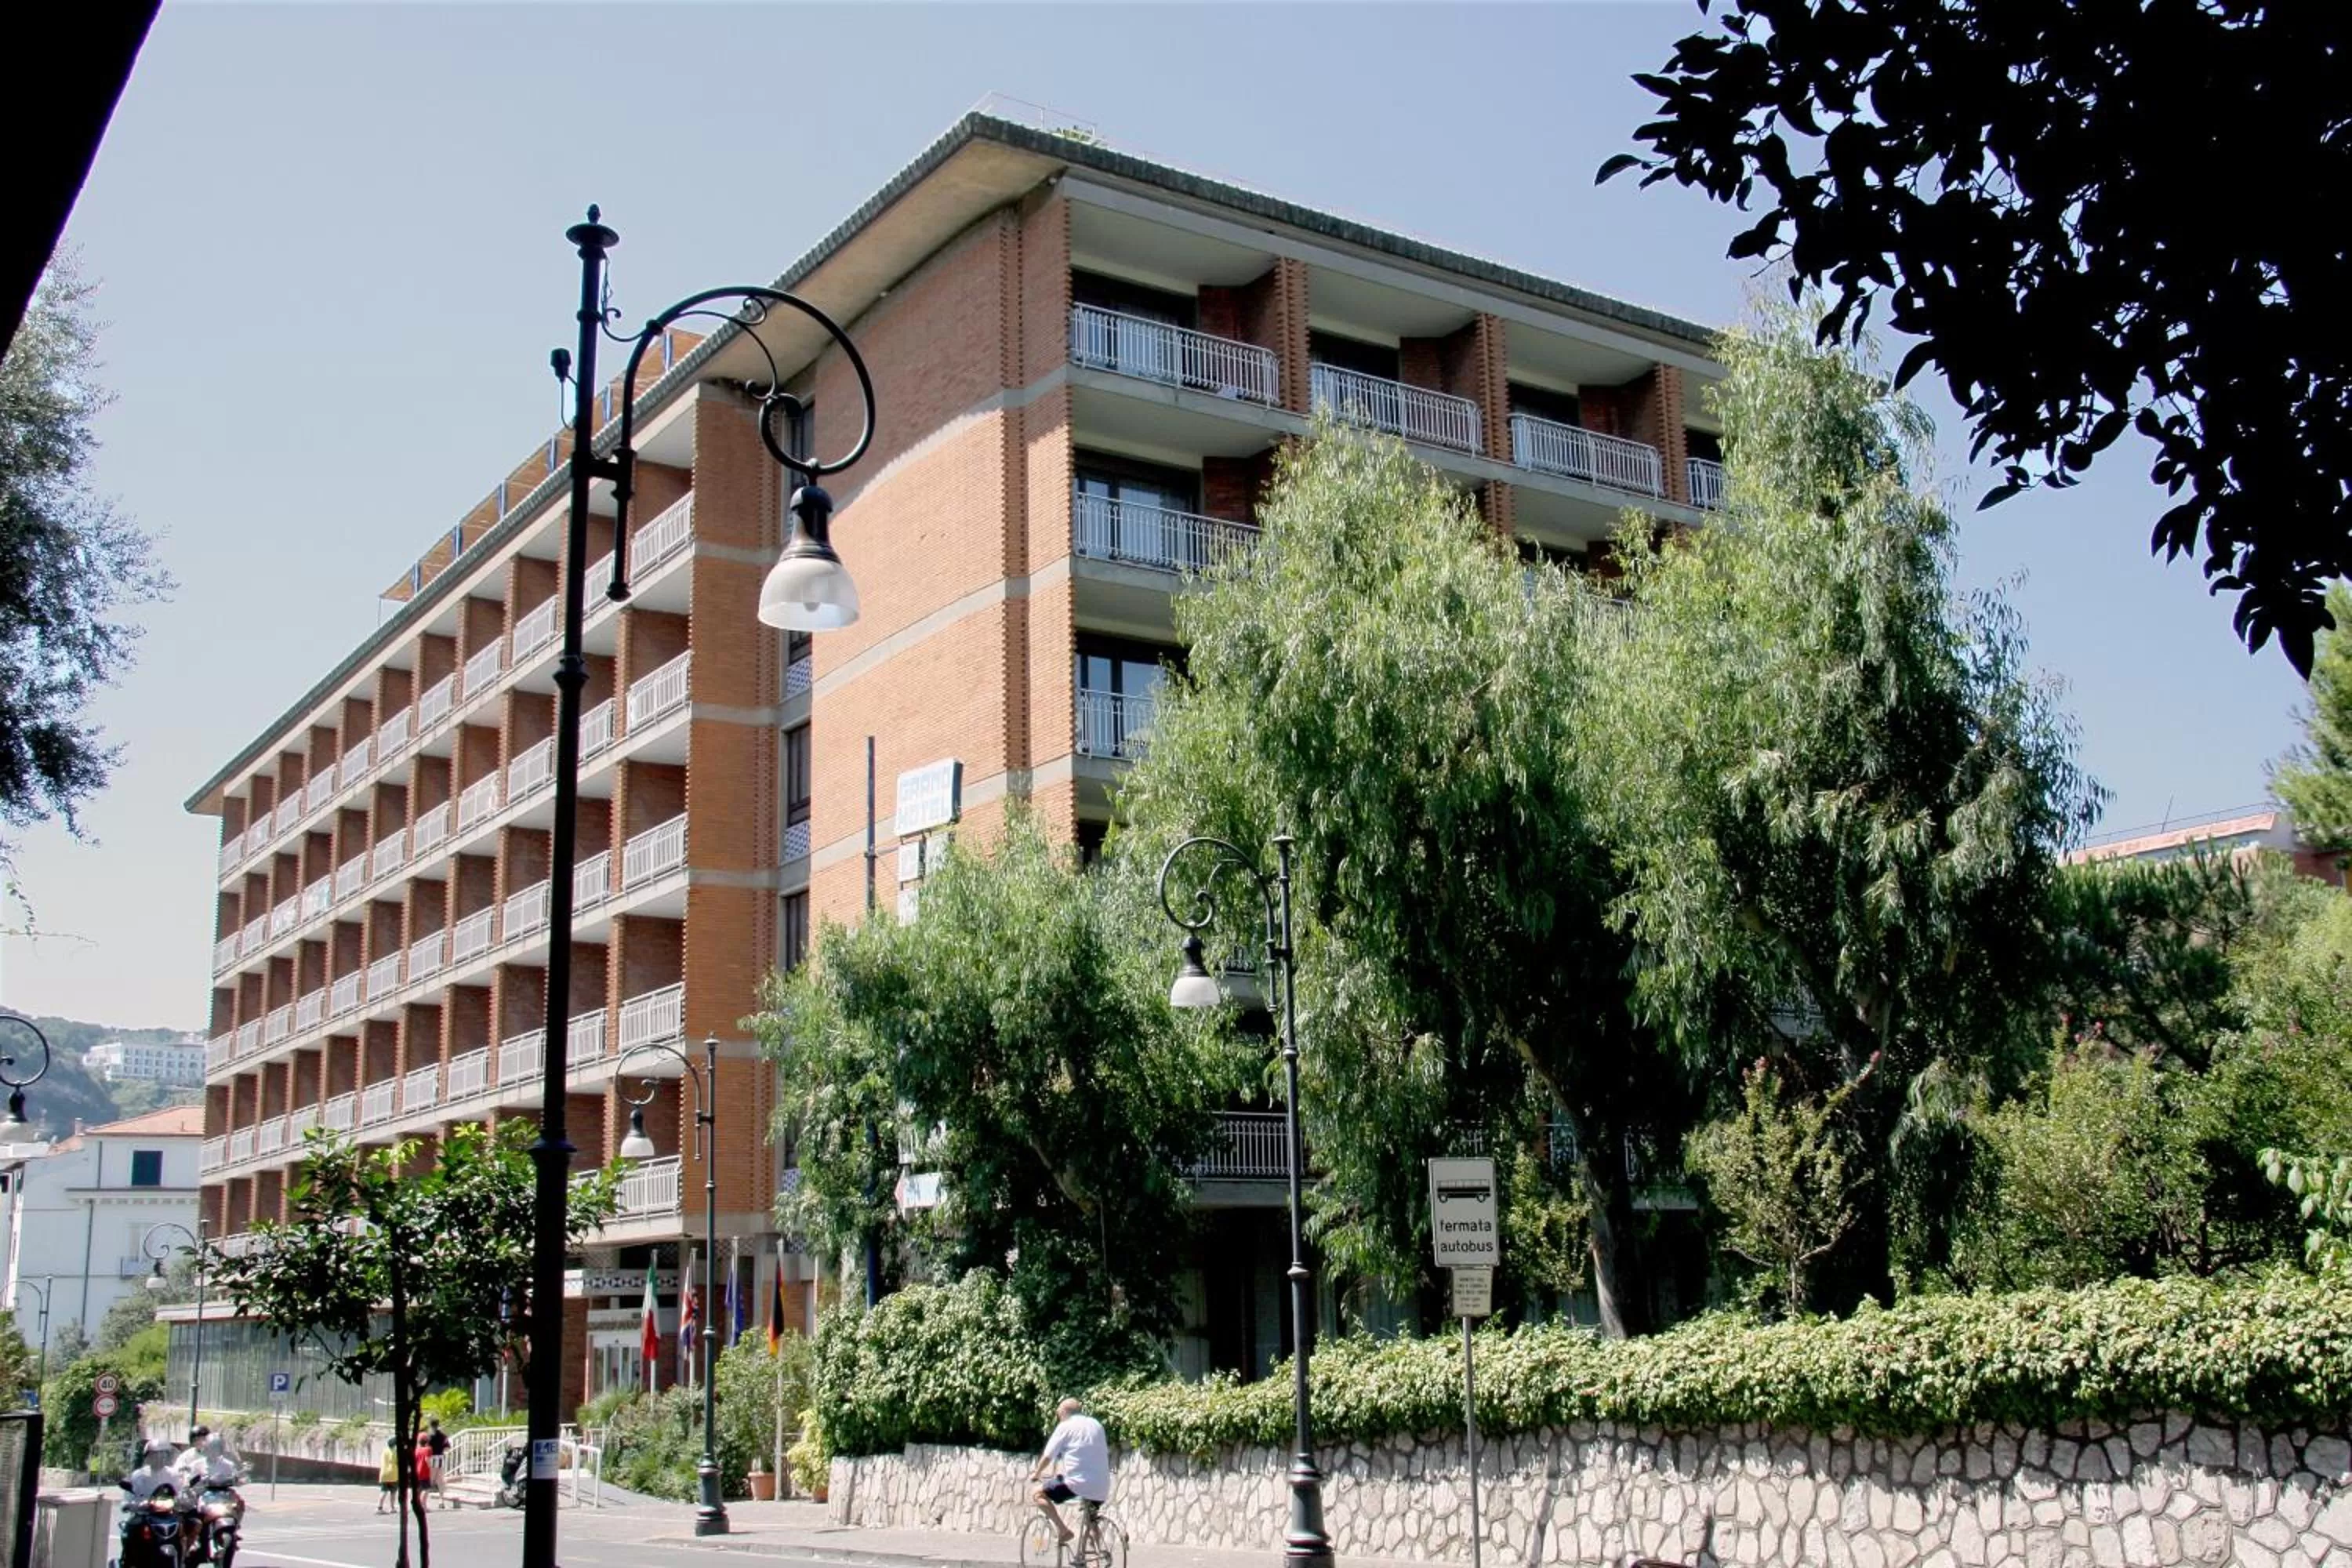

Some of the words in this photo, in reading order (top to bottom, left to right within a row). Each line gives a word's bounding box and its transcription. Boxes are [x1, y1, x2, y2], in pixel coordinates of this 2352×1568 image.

[901, 764, 951, 795] GRAND
[1439, 1218, 1492, 1232] fermata
[1439, 1240, 1494, 1253] autobus
[101, 1379, 114, 1388] 40
[274, 1374, 286, 1390] P
